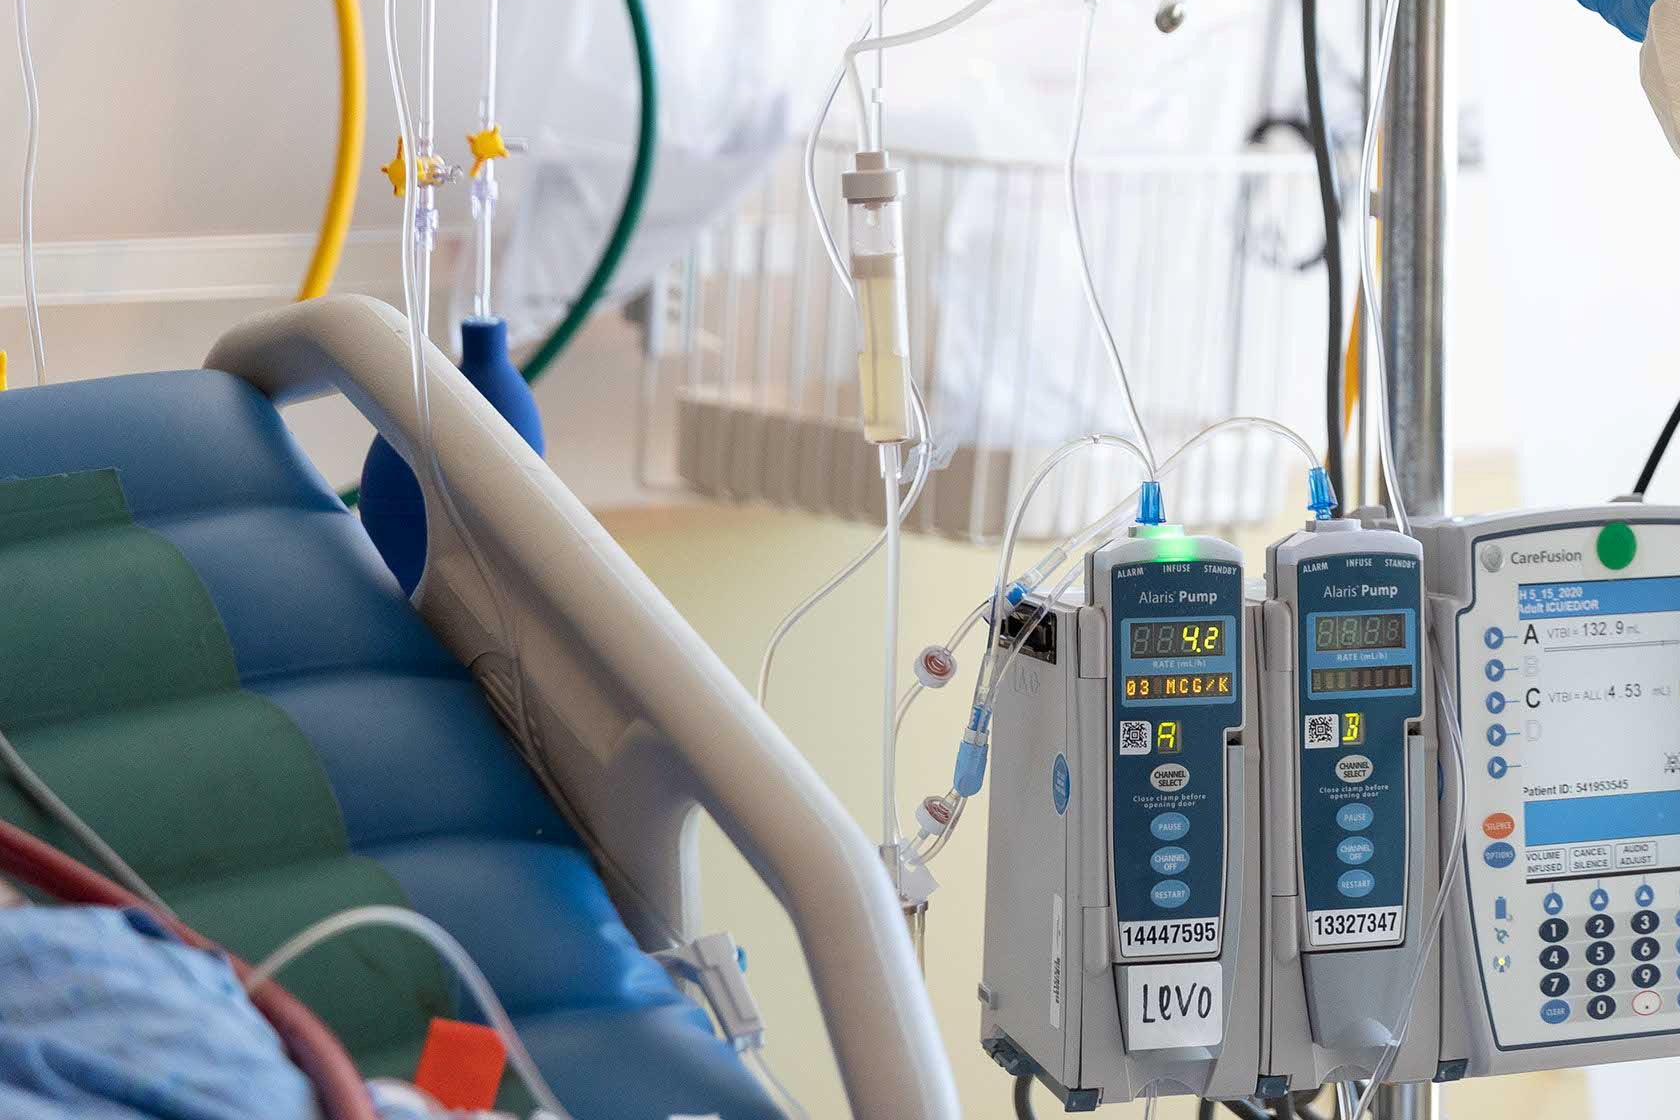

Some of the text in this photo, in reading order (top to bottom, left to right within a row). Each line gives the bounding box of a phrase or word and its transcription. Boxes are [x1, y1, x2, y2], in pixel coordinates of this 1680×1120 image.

[1511, 550, 1582, 565] CareFusion
[1117, 564, 1238, 578] ALARM INFUSE STANDBY
[1303, 558, 1416, 574] ALARM INFUSE STANDBY
[1323, 584, 1398, 598] Alaris Pump
[1139, 591, 1217, 605] Alaris Pump
[1182, 626, 1219, 653] 4.2
[1523, 624, 1539, 645] A
[1583, 621, 1624, 637] 132.9
[1337, 654, 1358, 662] RATE
[1152, 661, 1175, 669] RATE
[1127, 677, 1229, 696] 03 MCG/K
[1526, 688, 1541, 708] C
[1583, 691, 1601, 700] ALL
[1157, 721, 1177, 749] A
[1339, 762, 1369, 770] CHANNEL
[1154, 770, 1186, 779] CHANNEL
[1343, 770, 1366, 778] SELECT
[1158, 779, 1183, 787] SELECT
[1319, 786, 1339, 794] Close
[1341, 785, 1363, 793] clamp
[1330, 792, 1360, 800] opening
[1523, 784, 1556, 797] Patient
[1559, 784, 1573, 794] ID:
[1144, 801, 1176, 809] opening
[1340, 844, 1371, 853] CHANNEL
[1573, 847, 1607, 857] CANCEL
[1623, 844, 1649, 853] AUDIO
[1154, 855, 1186, 863] CHANNEL
[1350, 853, 1363, 861] OFF
[1526, 851, 1560, 861] VOLUME
[1620, 855, 1652, 865] ADJUST
[1164, 863, 1178, 871] OFF
[1527, 863, 1562, 873] INFUSED
[1573, 859, 1608, 869] SILENCE
[1341, 880, 1370, 889] RESTART
[1154, 890, 1185, 899] RESTART
[1315, 912, 1397, 936] 13327347
[1595, 920, 1604, 933] 2
[1641, 915, 1649, 929] 3
[1123, 922, 1216, 946] 14447595
[1551, 924, 1557, 937] 1
[1596, 947, 1605, 960] 5
[1641, 942, 1650, 956] 6
[1550, 951, 1559, 964] 4
[1596, 974, 1605, 987] 8
[1641, 969, 1651, 983] 9
[1551, 978, 1560, 991] 7
[1596, 1000, 1606, 1014] 0
